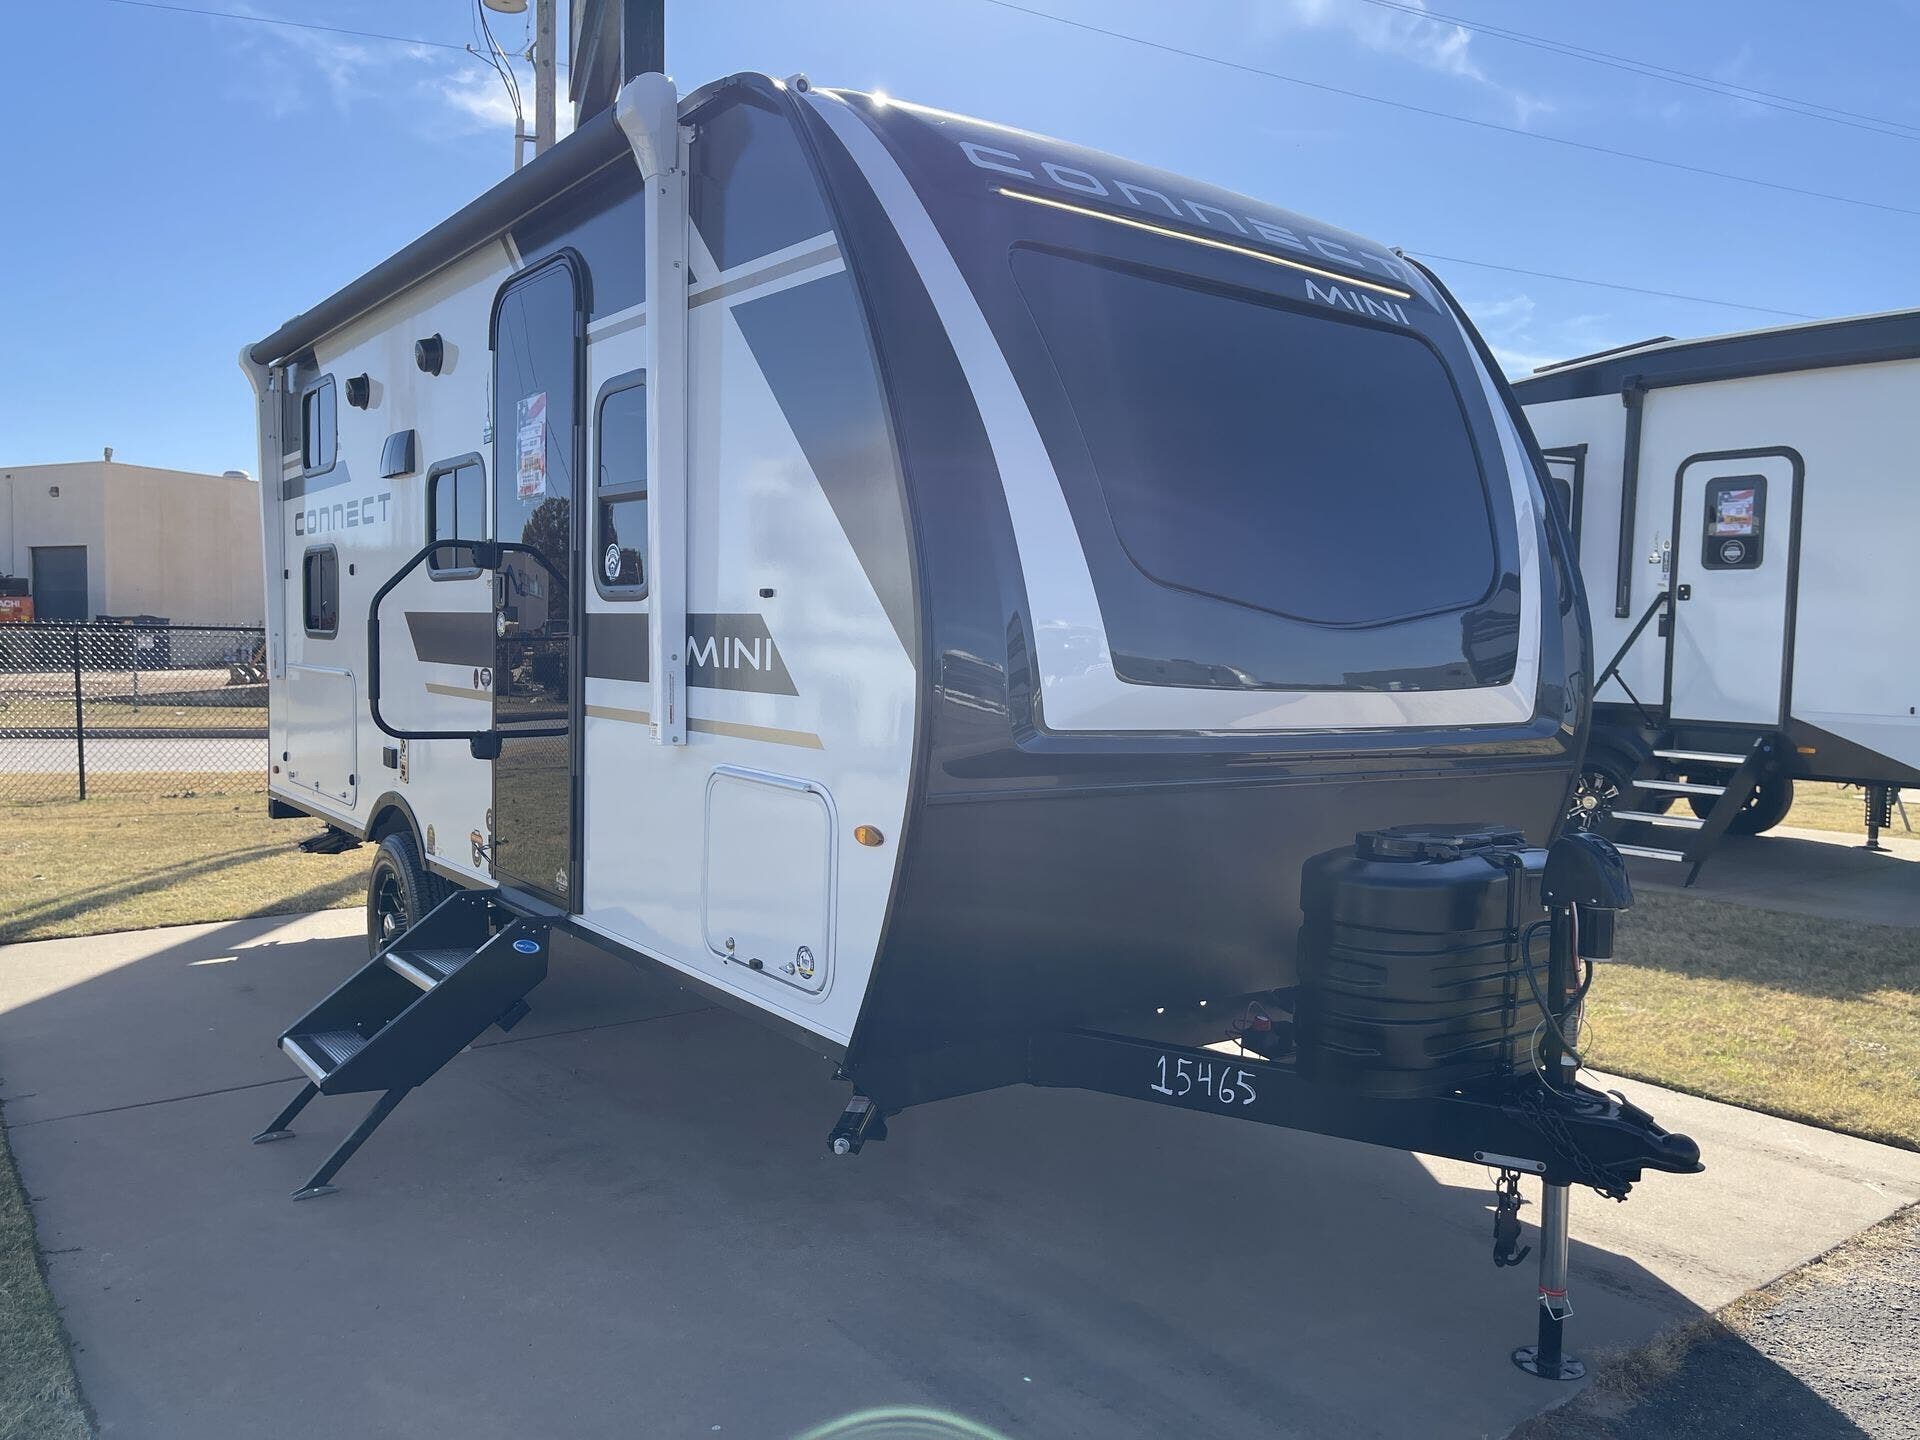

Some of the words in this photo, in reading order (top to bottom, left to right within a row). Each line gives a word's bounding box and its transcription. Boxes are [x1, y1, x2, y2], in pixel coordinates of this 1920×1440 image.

[959, 141, 1402, 280] CONNECT
[1304, 278, 1410, 325] MINI
[295, 492, 391, 537] CONNECT
[686, 635, 772, 671] MINI
[1150, 1055, 1257, 1105] 15465
